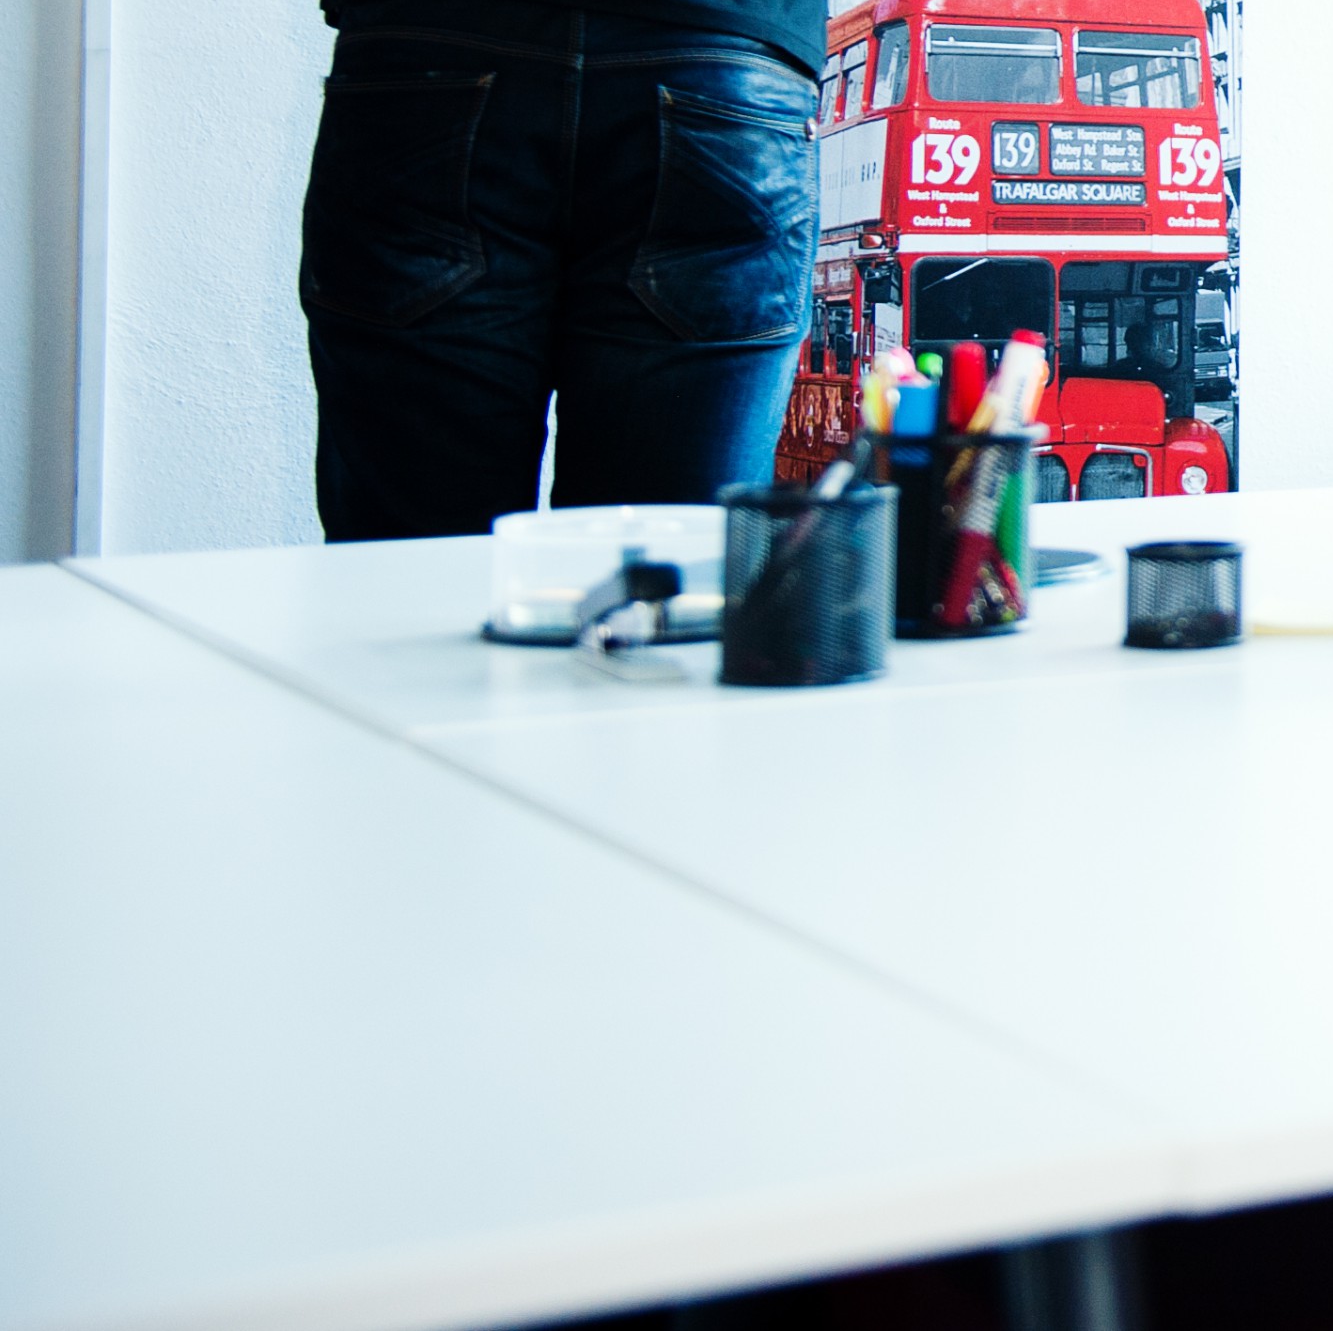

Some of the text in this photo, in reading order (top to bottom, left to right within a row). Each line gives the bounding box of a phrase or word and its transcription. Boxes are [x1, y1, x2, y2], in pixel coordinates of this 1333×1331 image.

[928, 117, 961, 130] Route
[1174, 123, 1203, 135] Route
[1051, 128, 1074, 140] West
[1077, 128, 1122, 144] Hampstead
[995, 132, 1036, 168] 139
[1056, 143, 1081, 158] Abbey
[1103, 143, 1126, 156] Baker
[911, 133, 981, 185] 139
[1052, 158, 1080, 170] Oxford
[1101, 159, 1129, 173] Regent
[1159, 137, 1221, 186] 139
[907, 190, 979, 203] West Hampstead
[994, 183, 1141, 201] TRAFALGAR SQUARE
[1158, 190, 1179, 201] West
[913, 216, 971, 227] Oxford Street
[1167, 217, 1195, 227] Oxford
